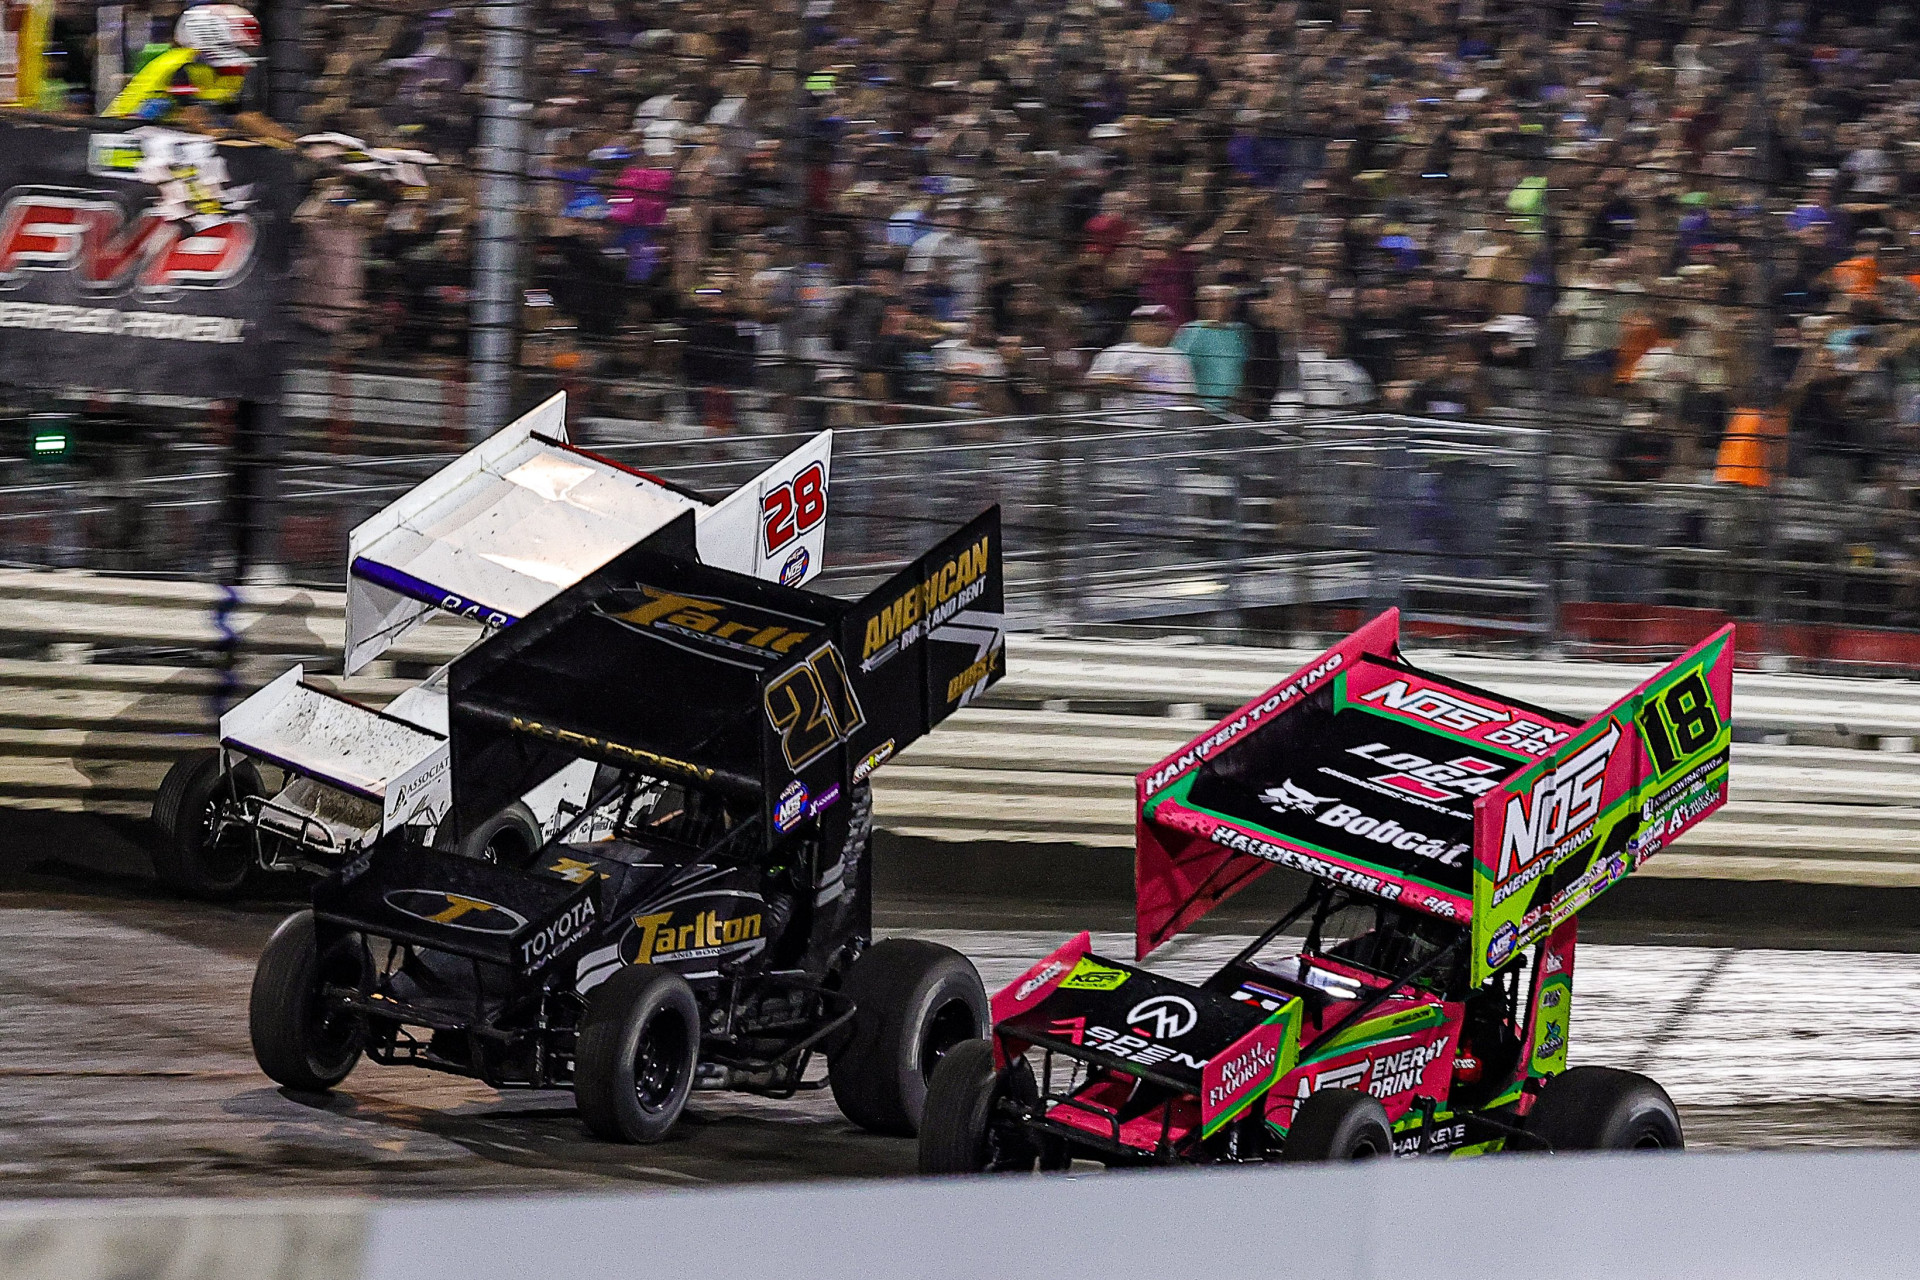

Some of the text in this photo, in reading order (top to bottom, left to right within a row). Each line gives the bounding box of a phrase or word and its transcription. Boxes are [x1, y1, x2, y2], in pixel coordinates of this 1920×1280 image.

[762, 462, 827, 557] 28
[765, 640, 866, 774] 21
[1248, 653, 1344, 721] TOWING
[1360, 679, 1570, 745] NOS EN
[1638, 664, 1721, 781] 18
[1315, 803, 1470, 865] Bobcat
[1497, 720, 1622, 883] NOS
[1211, 825, 1402, 901] HAUDENSCHILD
[1491, 855, 1552, 908] ENERGY
[1552, 823, 1594, 863] DRINK
[424, 894, 496, 923] T
[521, 896, 595, 964] TOYOTA
[633, 909, 762, 964] Tarlton
[1210, 1047, 1276, 1107] FLOORING
[1222, 1041, 1263, 1082] ROYAL
[1370, 1035, 1450, 1080] ENERGY
